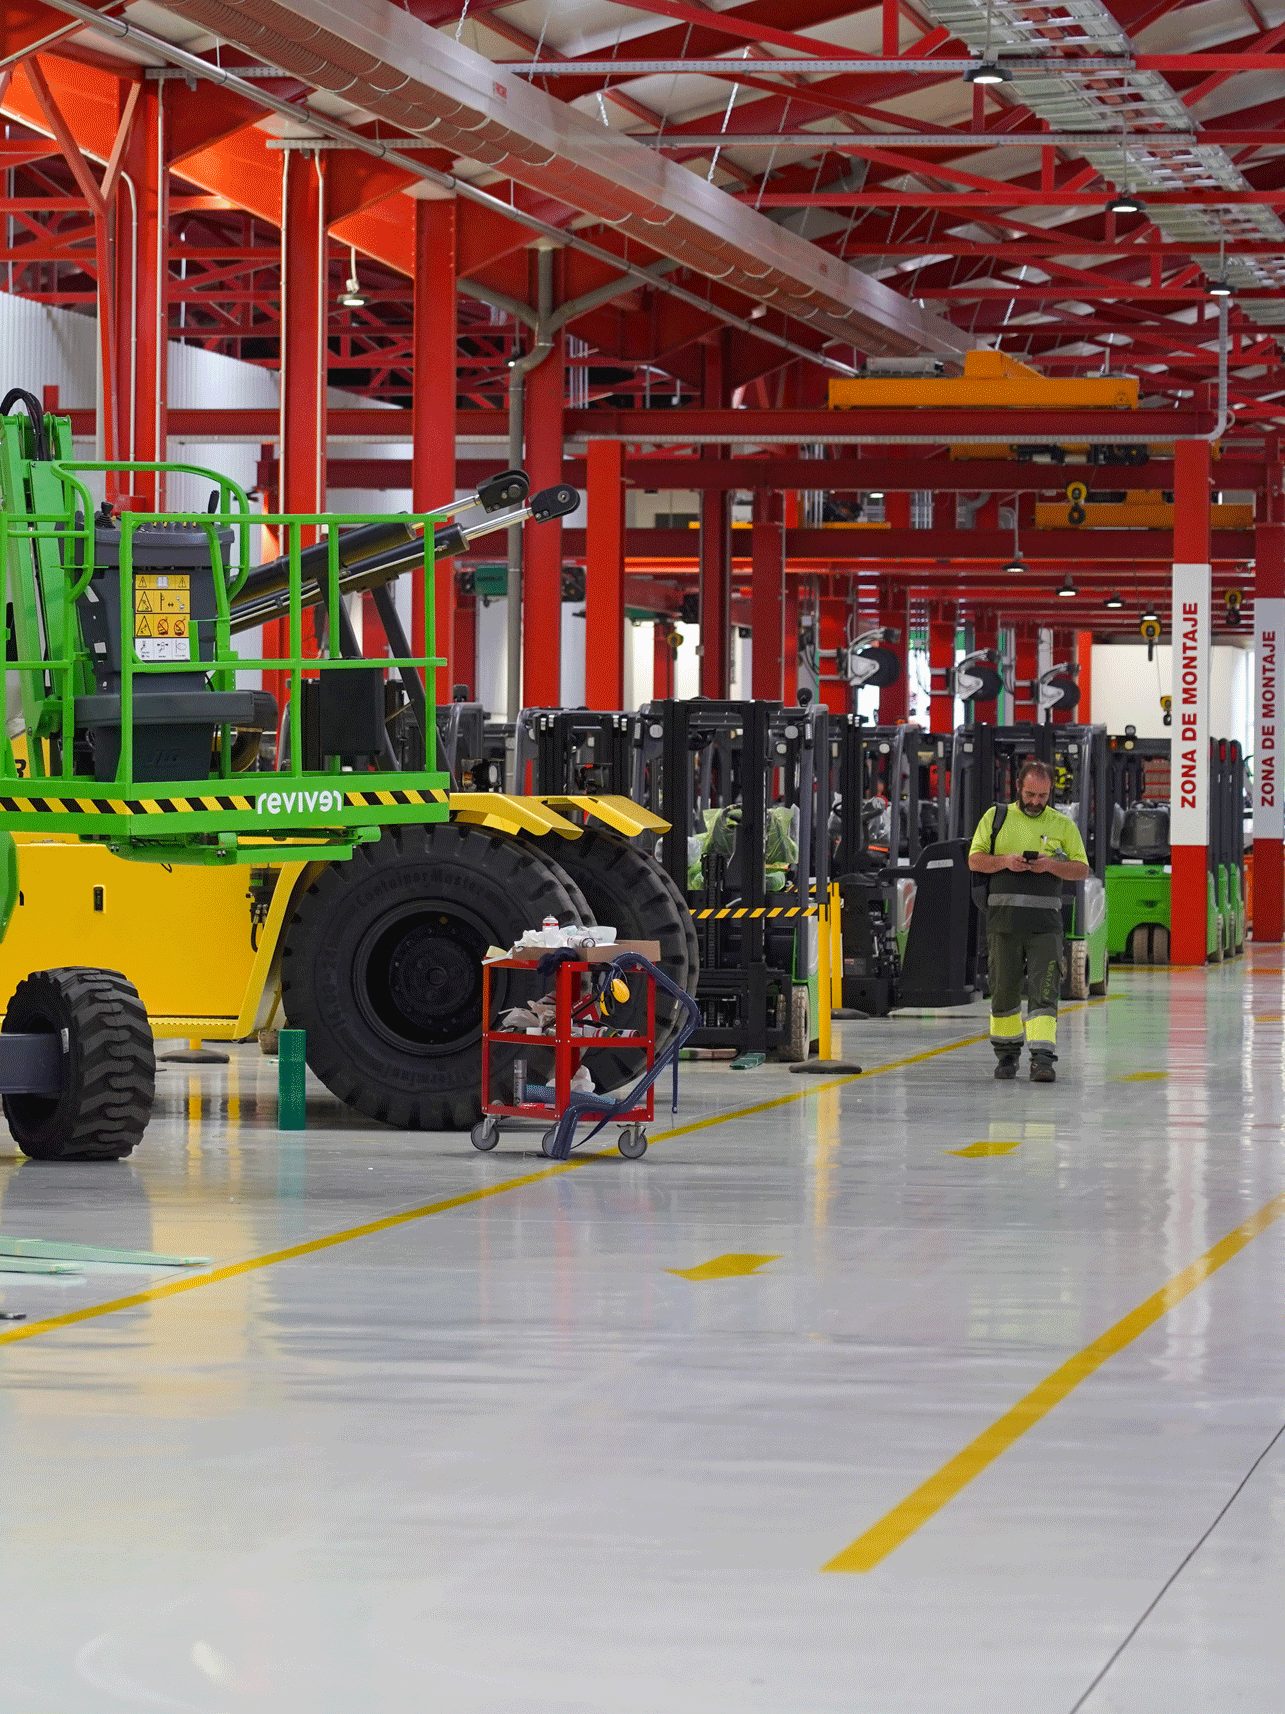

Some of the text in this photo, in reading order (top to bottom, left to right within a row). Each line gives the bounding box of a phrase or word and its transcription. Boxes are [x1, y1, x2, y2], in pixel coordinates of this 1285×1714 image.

[1180, 602, 1198, 809] ZONA DE MONTAJE
[1260, 631, 1276, 807] ZONA DE MONTAJE
